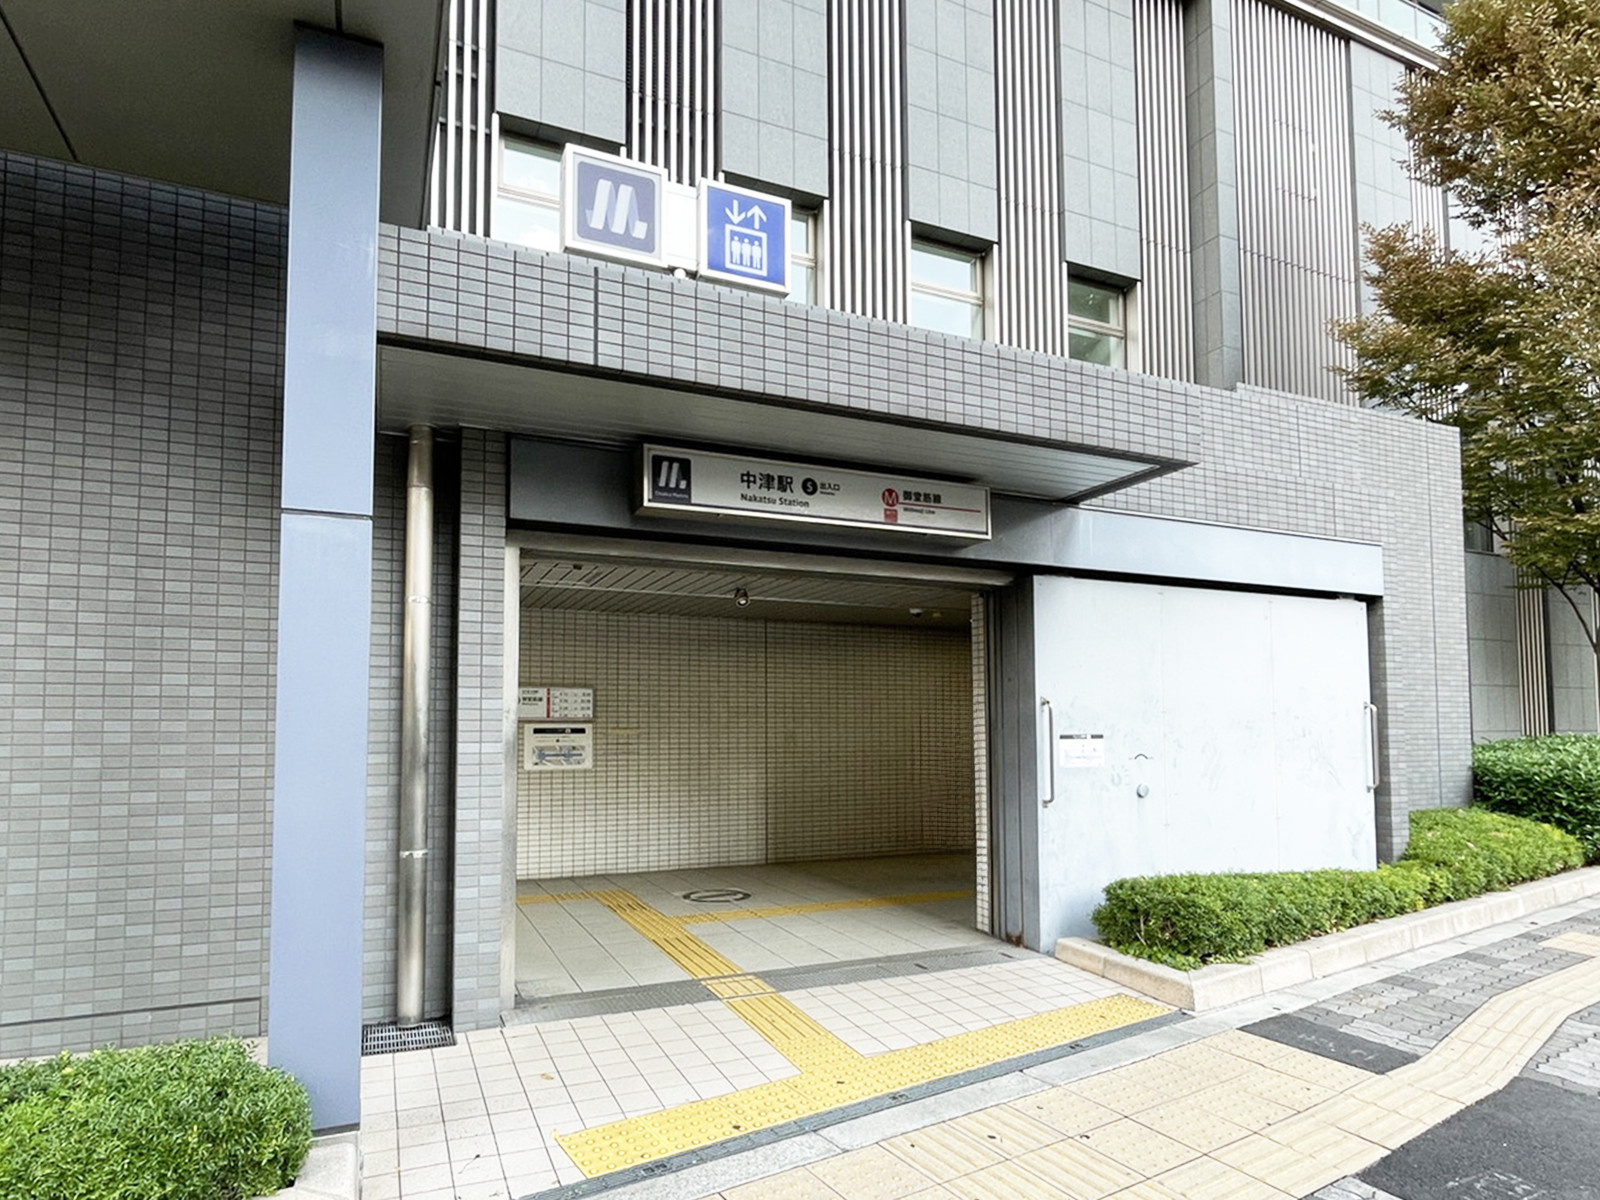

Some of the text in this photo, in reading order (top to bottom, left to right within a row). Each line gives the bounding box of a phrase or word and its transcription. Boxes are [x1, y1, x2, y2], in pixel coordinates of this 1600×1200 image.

[740, 470, 794, 493] 中津駅
[740, 493, 810, 508] Nakatsu Station
